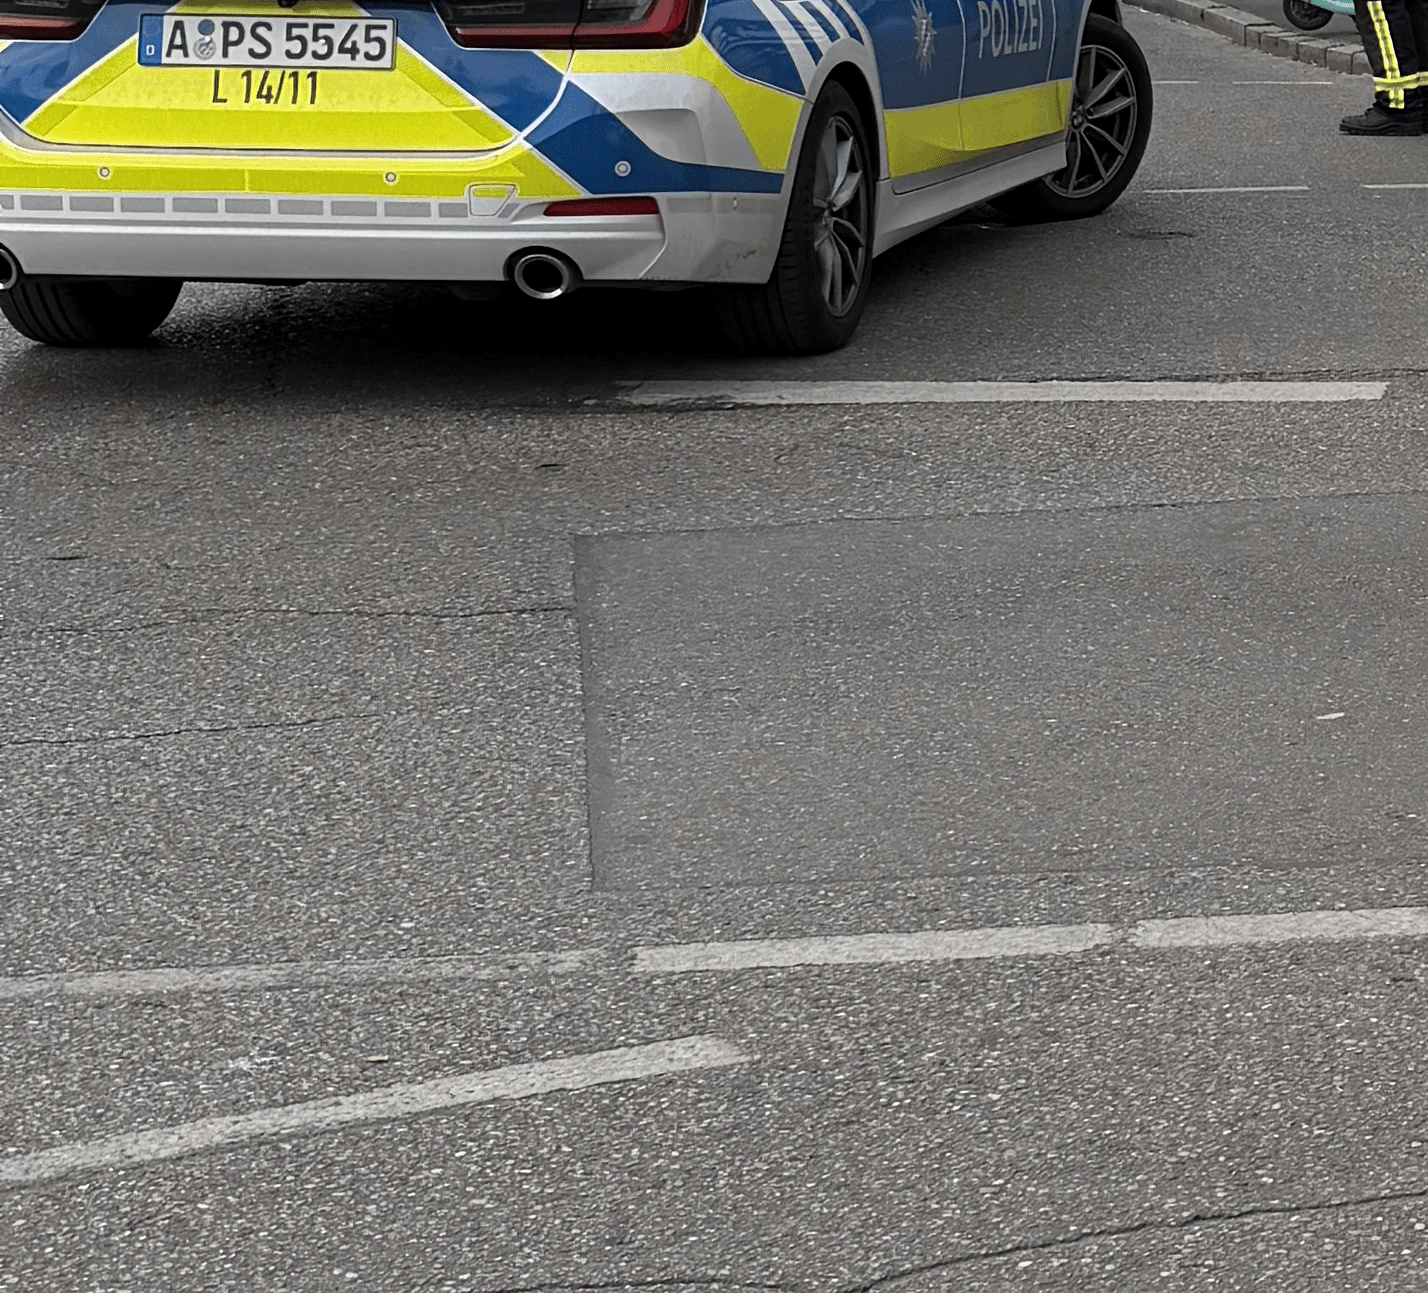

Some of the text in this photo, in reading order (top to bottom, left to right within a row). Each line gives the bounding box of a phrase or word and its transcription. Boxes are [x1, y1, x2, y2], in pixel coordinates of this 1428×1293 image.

[165, 19, 190, 59] A
[222, 21, 273, 60] PS
[284, 22, 388, 62] 5545
[212, 69, 318, 105] L 14/11
